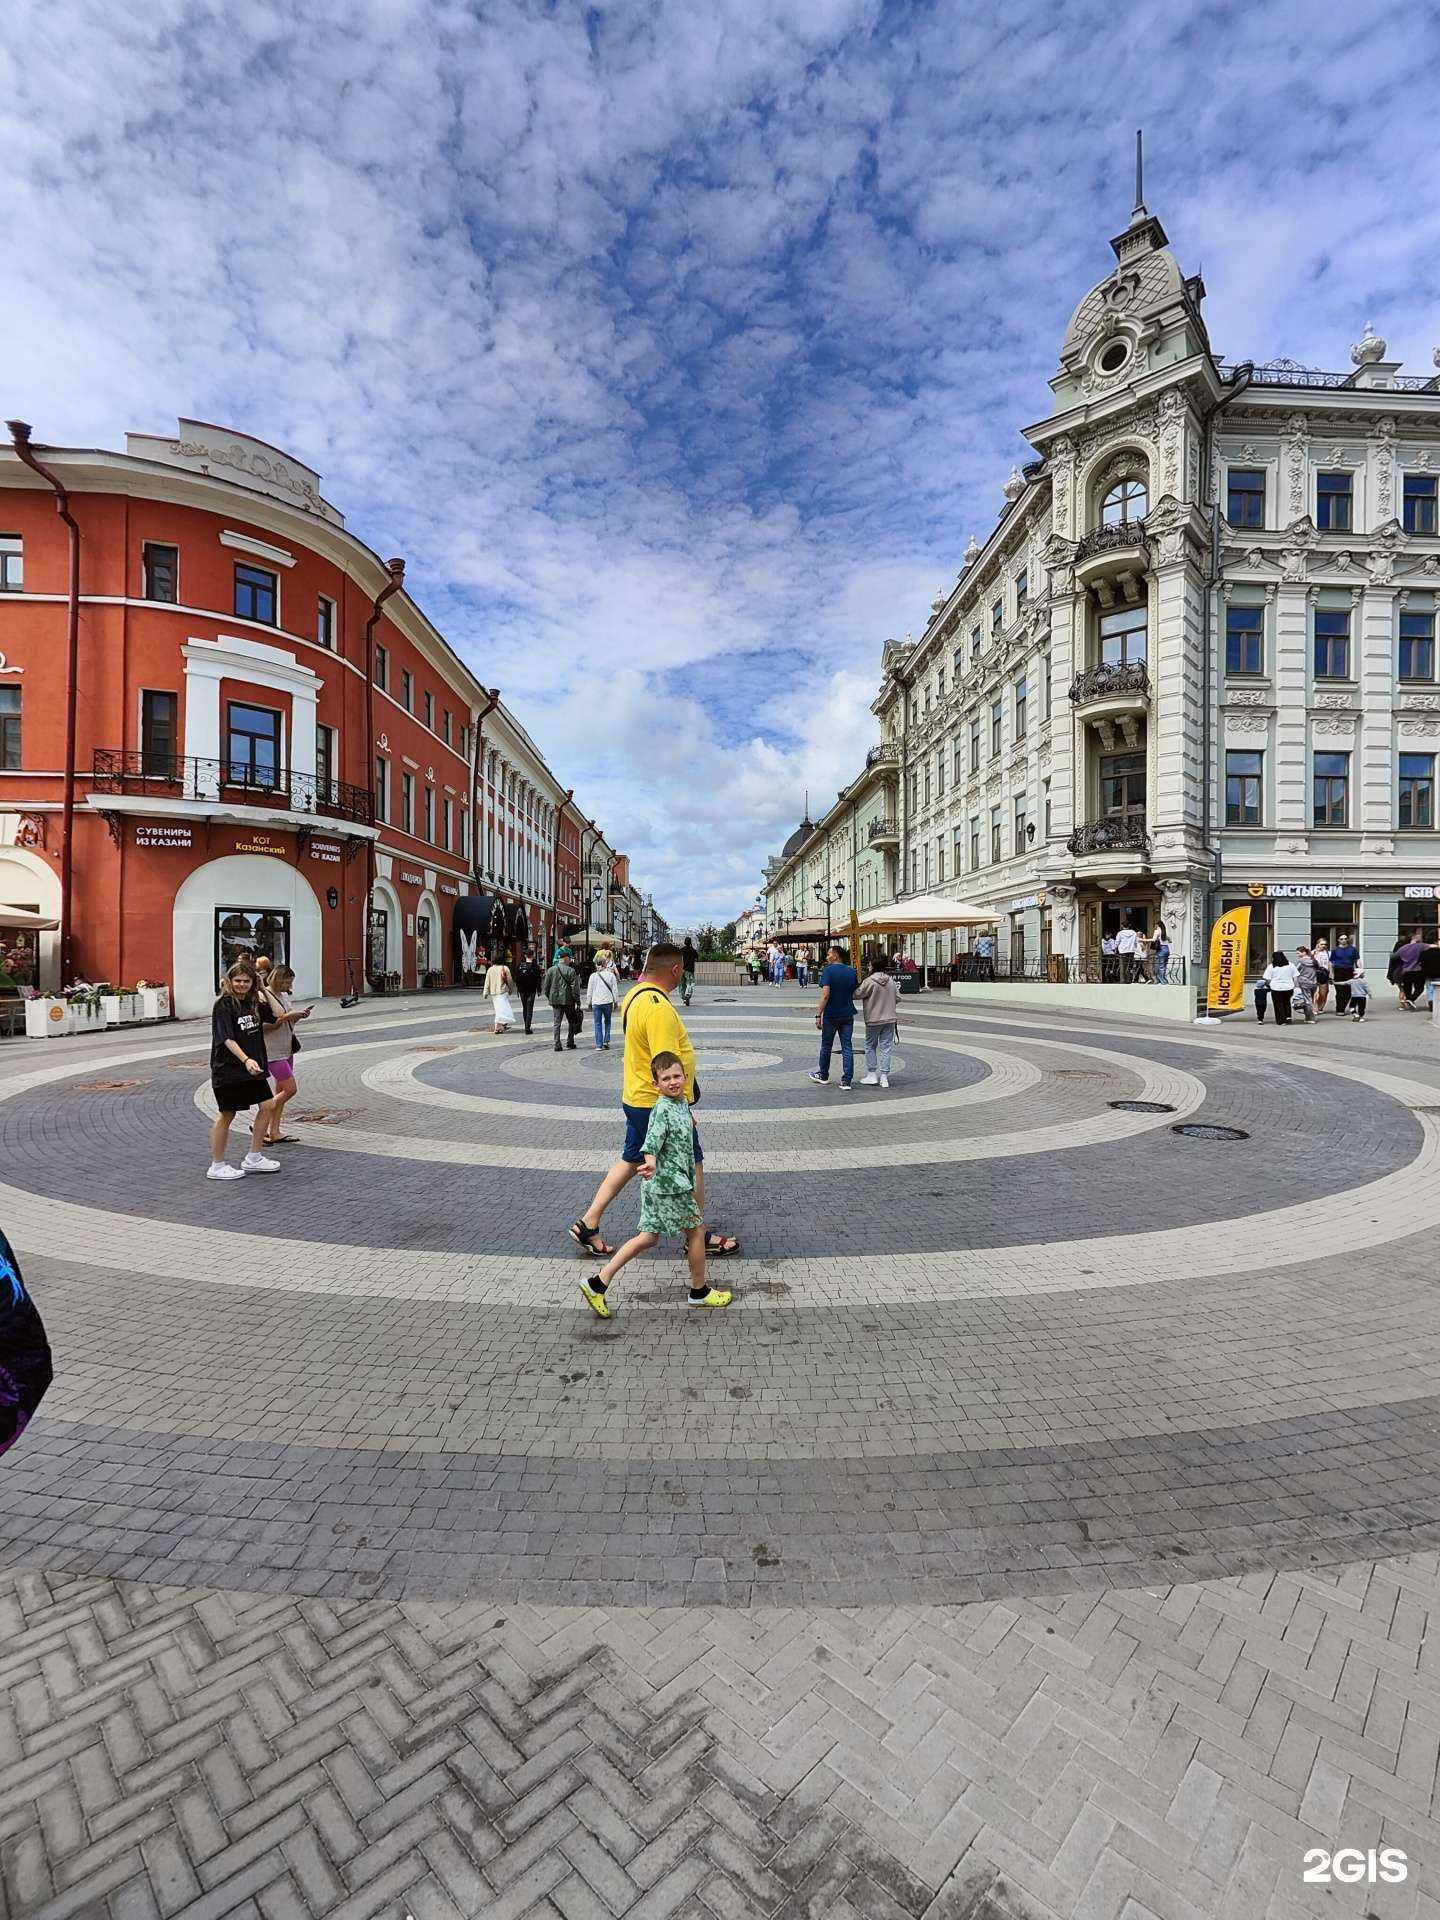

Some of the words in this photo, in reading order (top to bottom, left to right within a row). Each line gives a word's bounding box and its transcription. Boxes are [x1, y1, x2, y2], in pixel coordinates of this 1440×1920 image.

[136, 827, 192, 837] СУВЕНИРЫ
[136, 837, 150, 846] ИЗ
[151, 838, 192, 847] КАЗАНИ
[253, 836, 271, 845] КОТ
[235, 842, 286, 854] Казанский
[1266, 883, 1343, 897] КЫСТЫБЫЙ
[1218, 940, 1234, 1006] КЫСТЫБЫЙ
